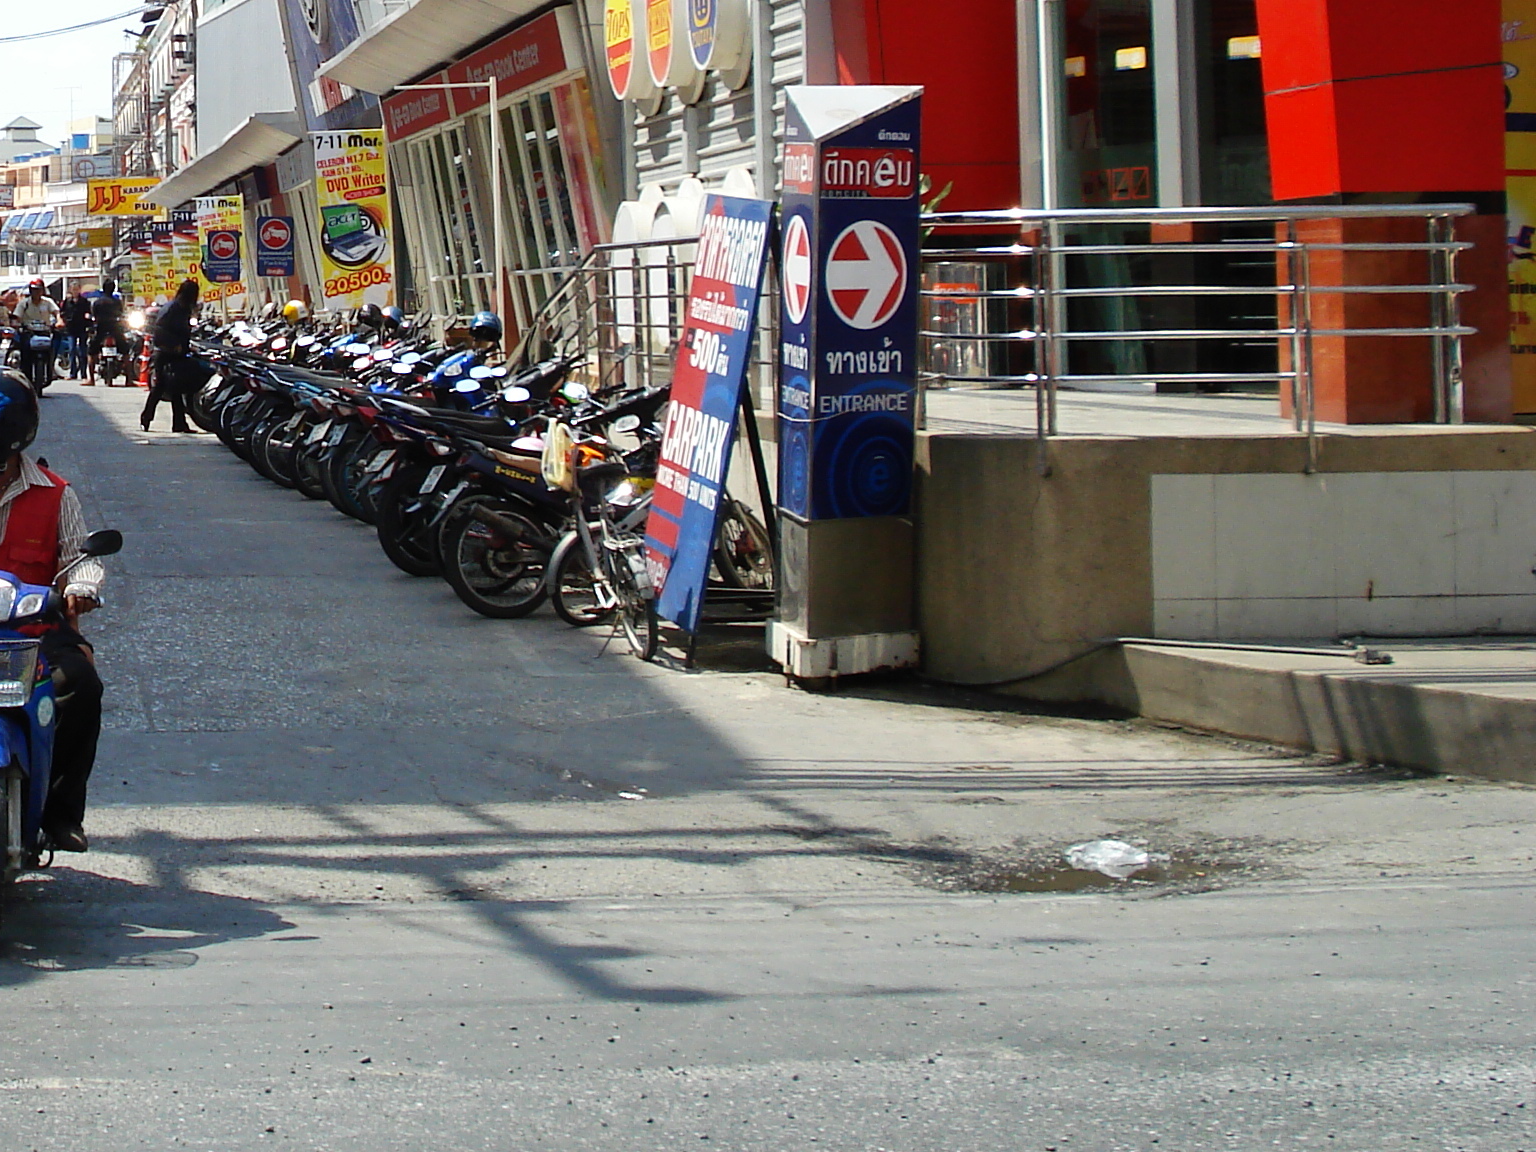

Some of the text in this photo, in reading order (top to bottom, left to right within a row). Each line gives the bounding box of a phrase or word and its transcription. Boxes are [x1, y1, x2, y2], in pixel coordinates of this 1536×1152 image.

[606, 7, 630, 42] TOPS
[315, 136, 342, 149] 7-11
[326, 173, 386, 193] DVD Writer
[89, 184, 127, 212] J.J.
[134, 202, 156, 211] PUB
[327, 211, 357, 228] acer
[689, 328, 721, 374] 500
[826, 336, 903, 375] ทางเข้า
[819, 393, 909, 414] ENTRANCE
[661, 399, 731, 484] CARPARK
